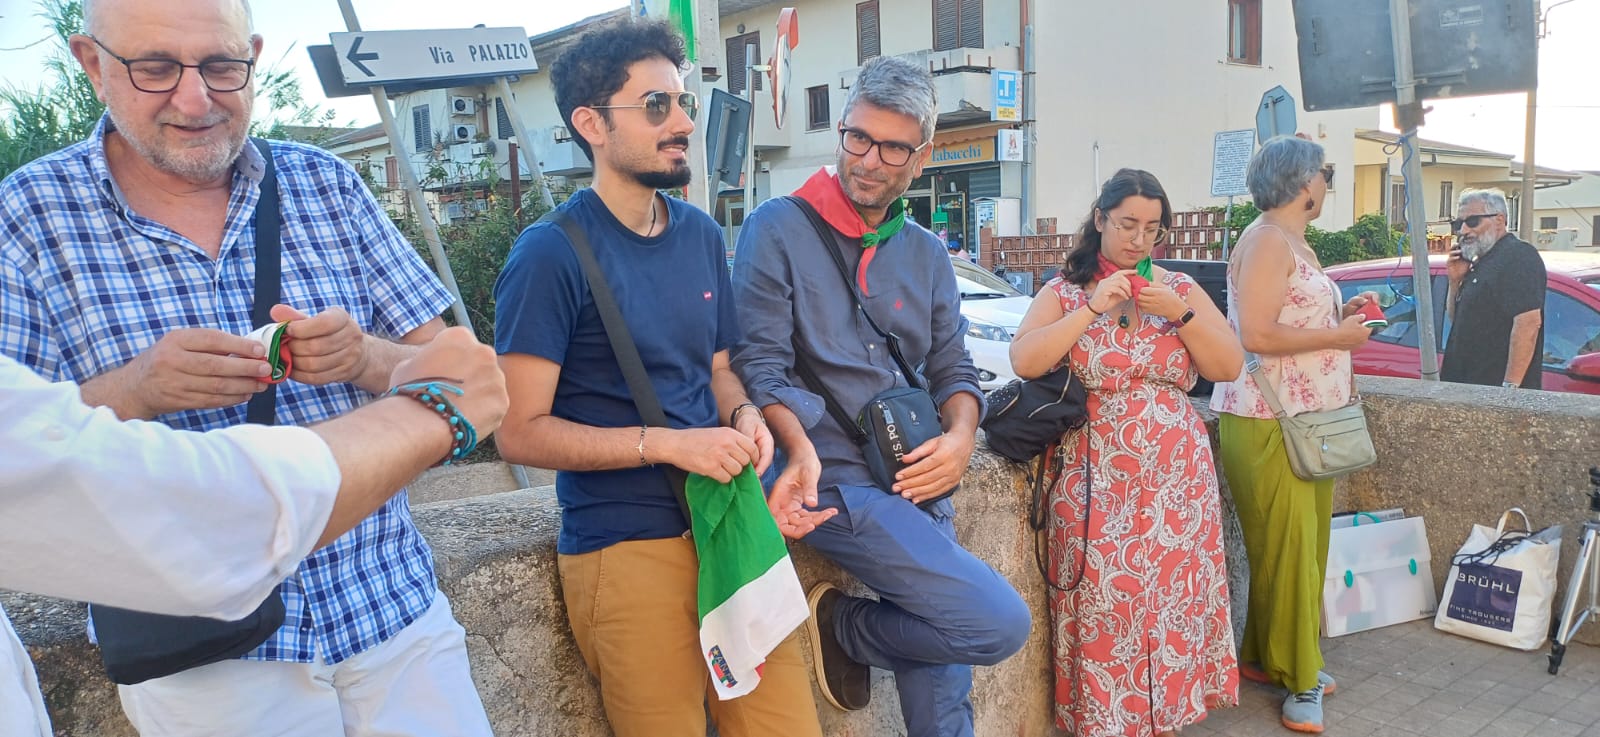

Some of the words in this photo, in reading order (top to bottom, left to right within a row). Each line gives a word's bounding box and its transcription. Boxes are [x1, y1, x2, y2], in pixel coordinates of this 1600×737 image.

[429, 46, 455, 65] Via
[468, 43, 528, 62] PALAZZO
[1457, 572, 1515, 594] BRÜHL
